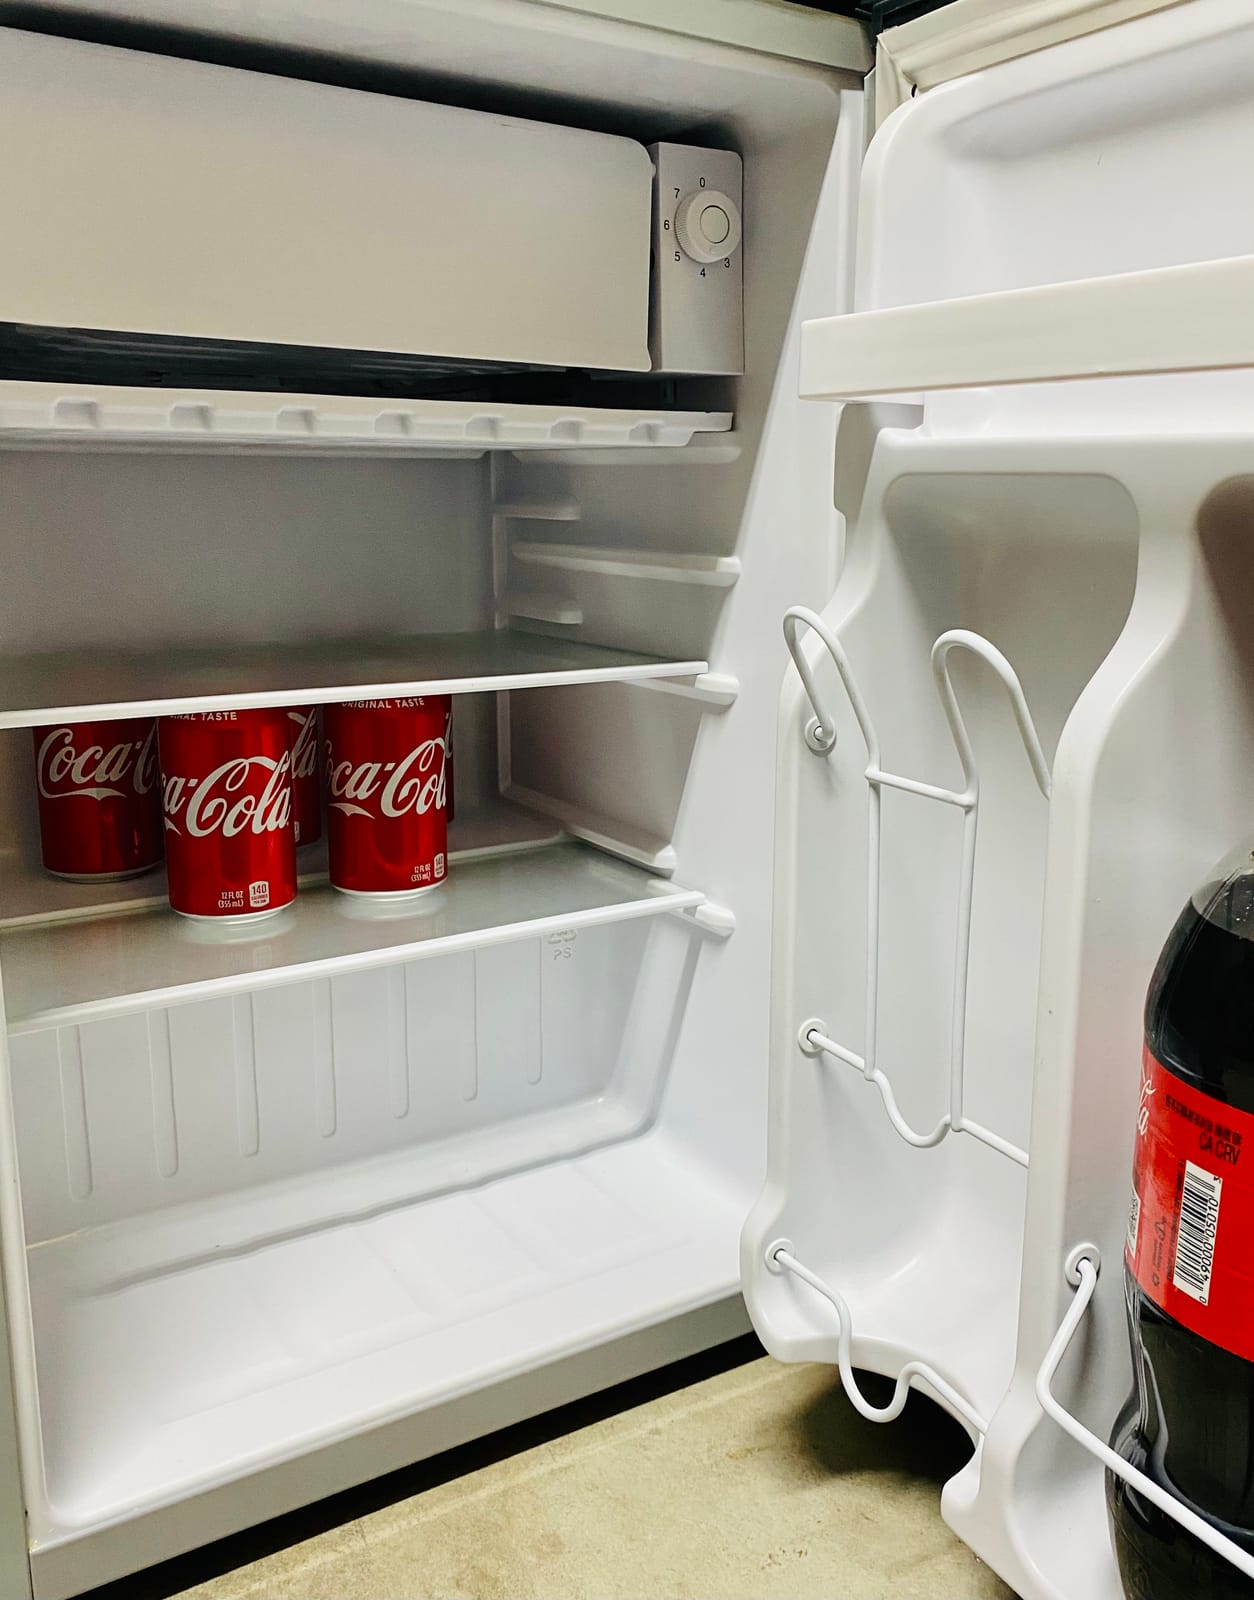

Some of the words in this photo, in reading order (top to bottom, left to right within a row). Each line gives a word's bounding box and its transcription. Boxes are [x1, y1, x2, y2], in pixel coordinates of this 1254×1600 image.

[699, 177, 706, 188] 0
[673, 188, 681, 198] 7
[663, 219, 670, 230] 6
[674, 251, 681, 262] 5
[724, 257, 731, 268] 3
[699, 268, 706, 278] 4
[395, 697, 425, 708] TASTE
[201, 711, 238, 721] TASTE
[221, 891, 228, 900] 12
[228, 891, 236, 900] FL
[235, 890, 244, 899] OZ
[252, 883, 267, 896] 140
[217, 899, 231, 909] (355
[231, 899, 244, 908] mL)
[1199, 1131, 1213, 1155] CA
[1215, 1139, 1241, 1166] CRV
[1204, 1195, 1219, 1239] 05010
[1200, 1241, 1214, 1283] 49000
